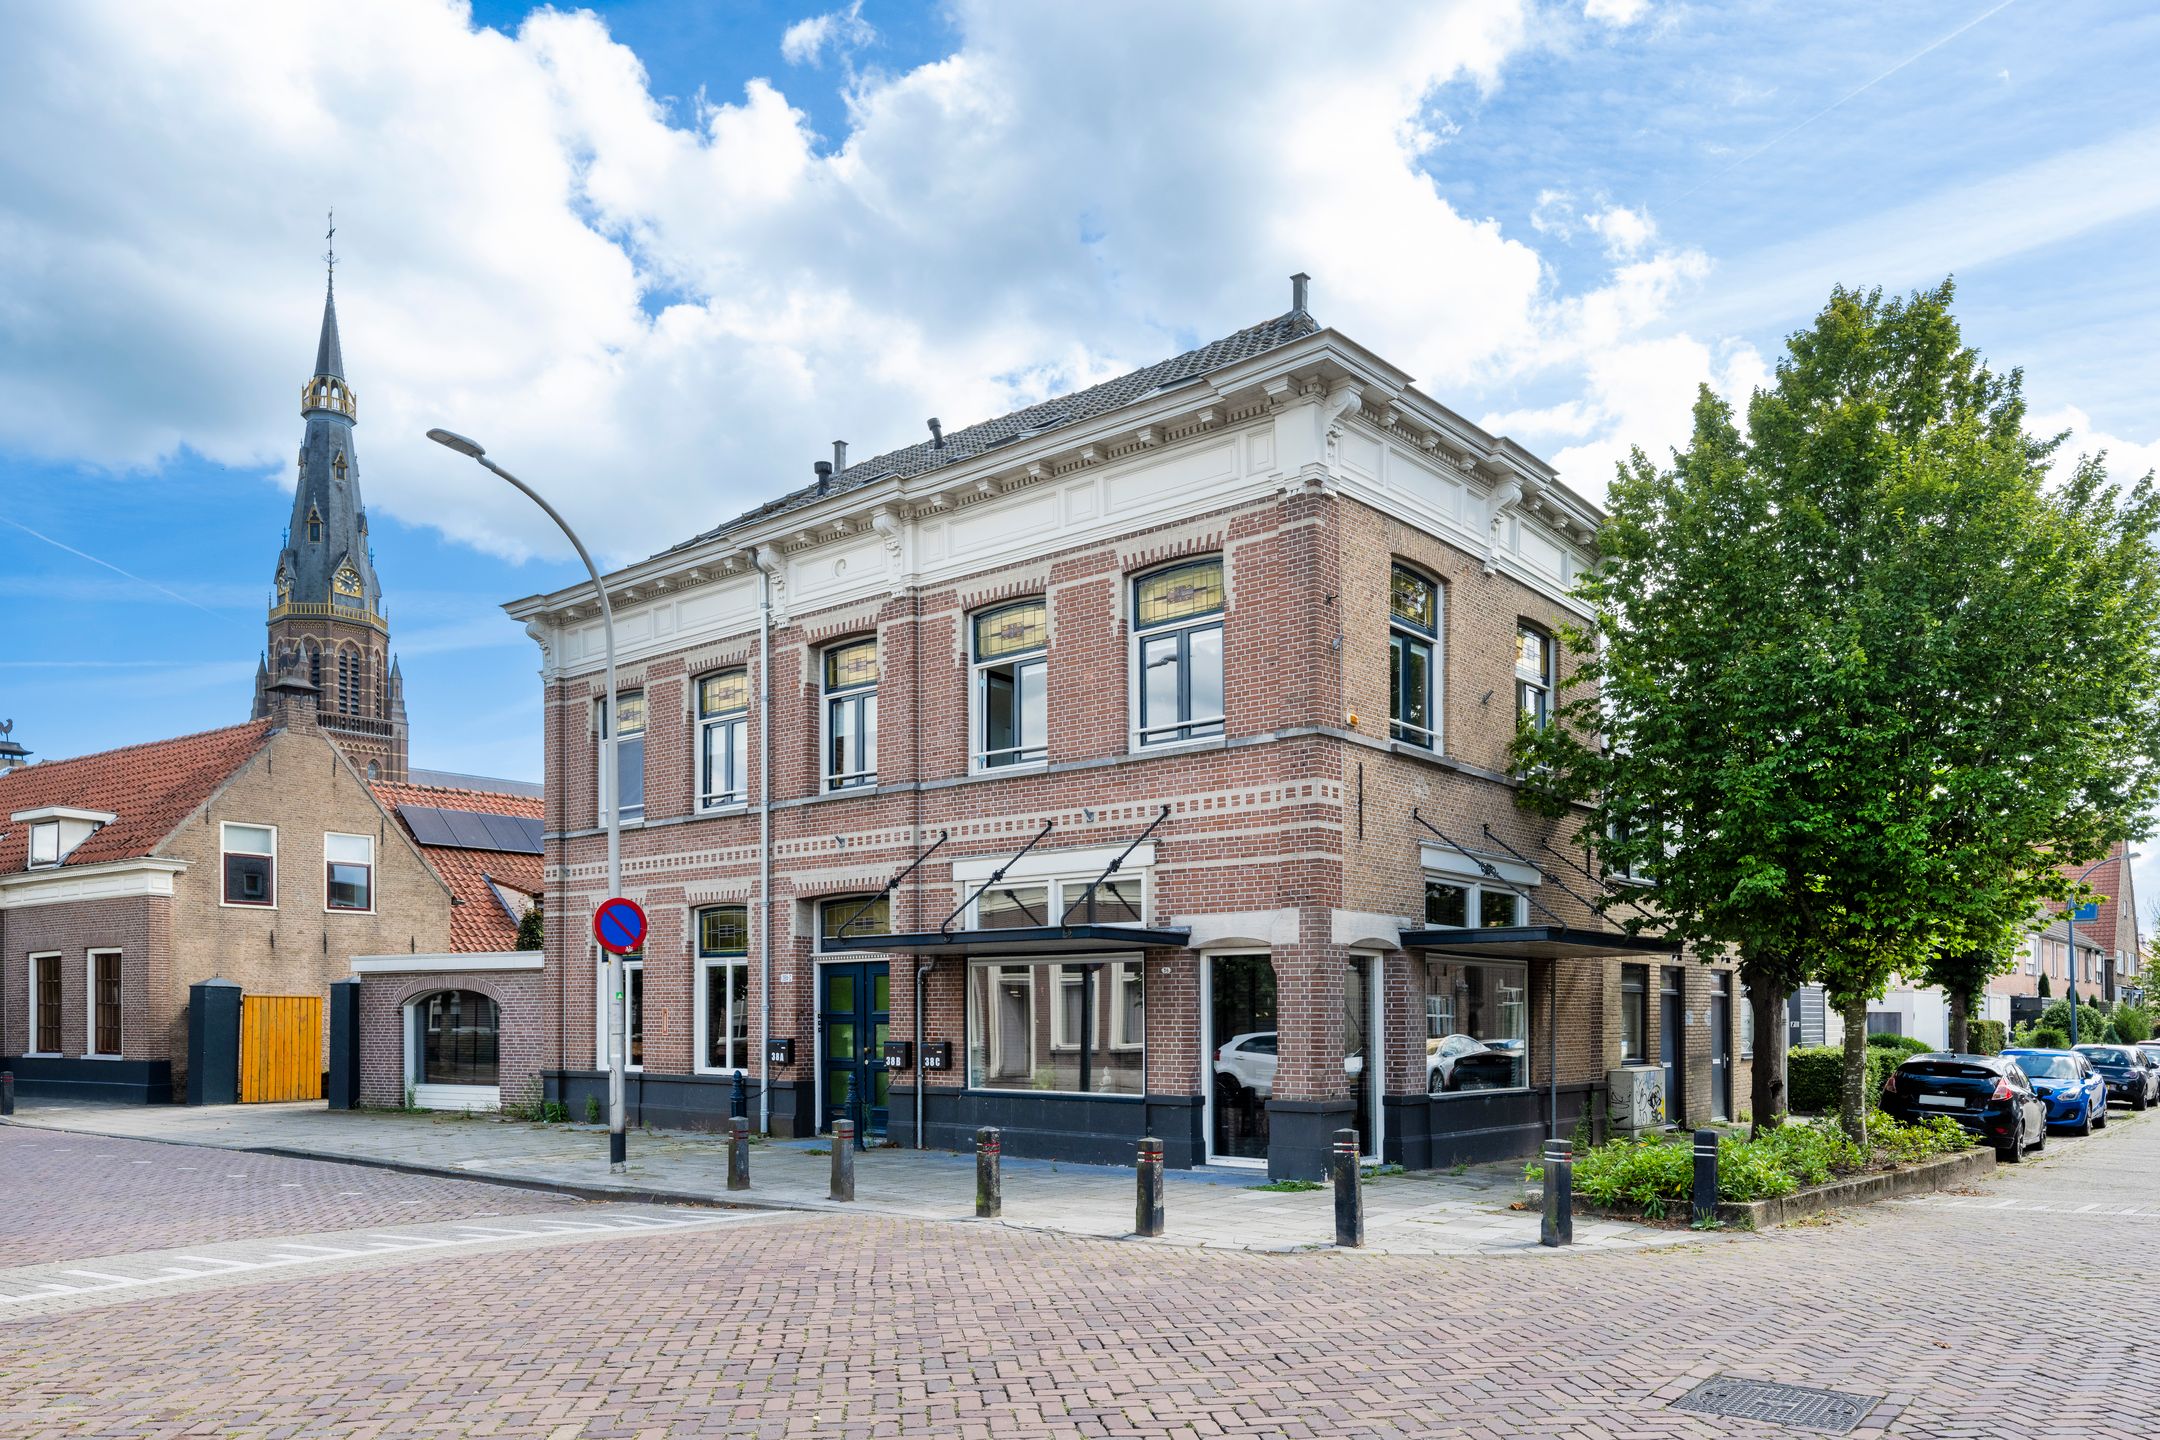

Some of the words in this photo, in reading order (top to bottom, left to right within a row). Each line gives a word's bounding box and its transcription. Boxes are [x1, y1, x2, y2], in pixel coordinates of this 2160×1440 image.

[771, 1052, 784, 1061] 38A
[886, 1056, 901, 1066] 38B
[925, 1057, 940, 1067] 38C
